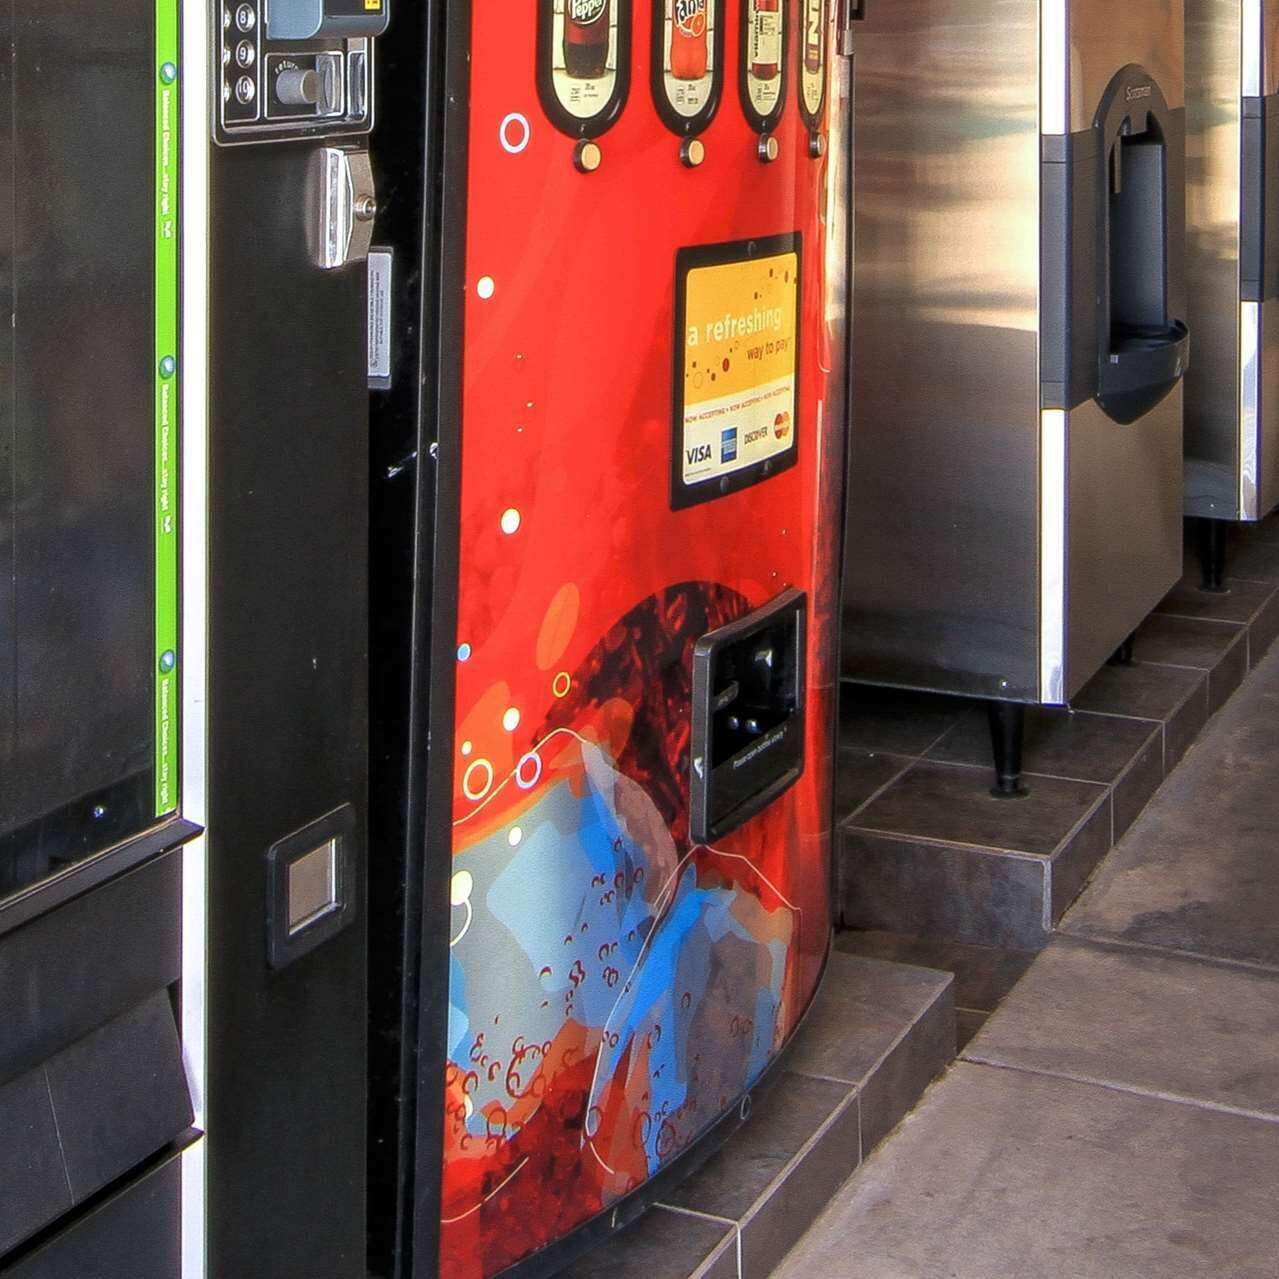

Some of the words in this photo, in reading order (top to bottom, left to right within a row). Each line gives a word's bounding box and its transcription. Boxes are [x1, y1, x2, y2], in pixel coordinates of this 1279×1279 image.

[239, 12, 247, 24] 8
[239, 48, 247, 61] 9
[239, 82, 249, 96] 10
[687, 325, 699, 347] a
[704, 307, 784, 344] refreshing
[747, 344, 765, 361] way
[766, 341, 775, 355] to
[775, 337, 791, 355] pay
[686, 444, 712, 465] VISA
